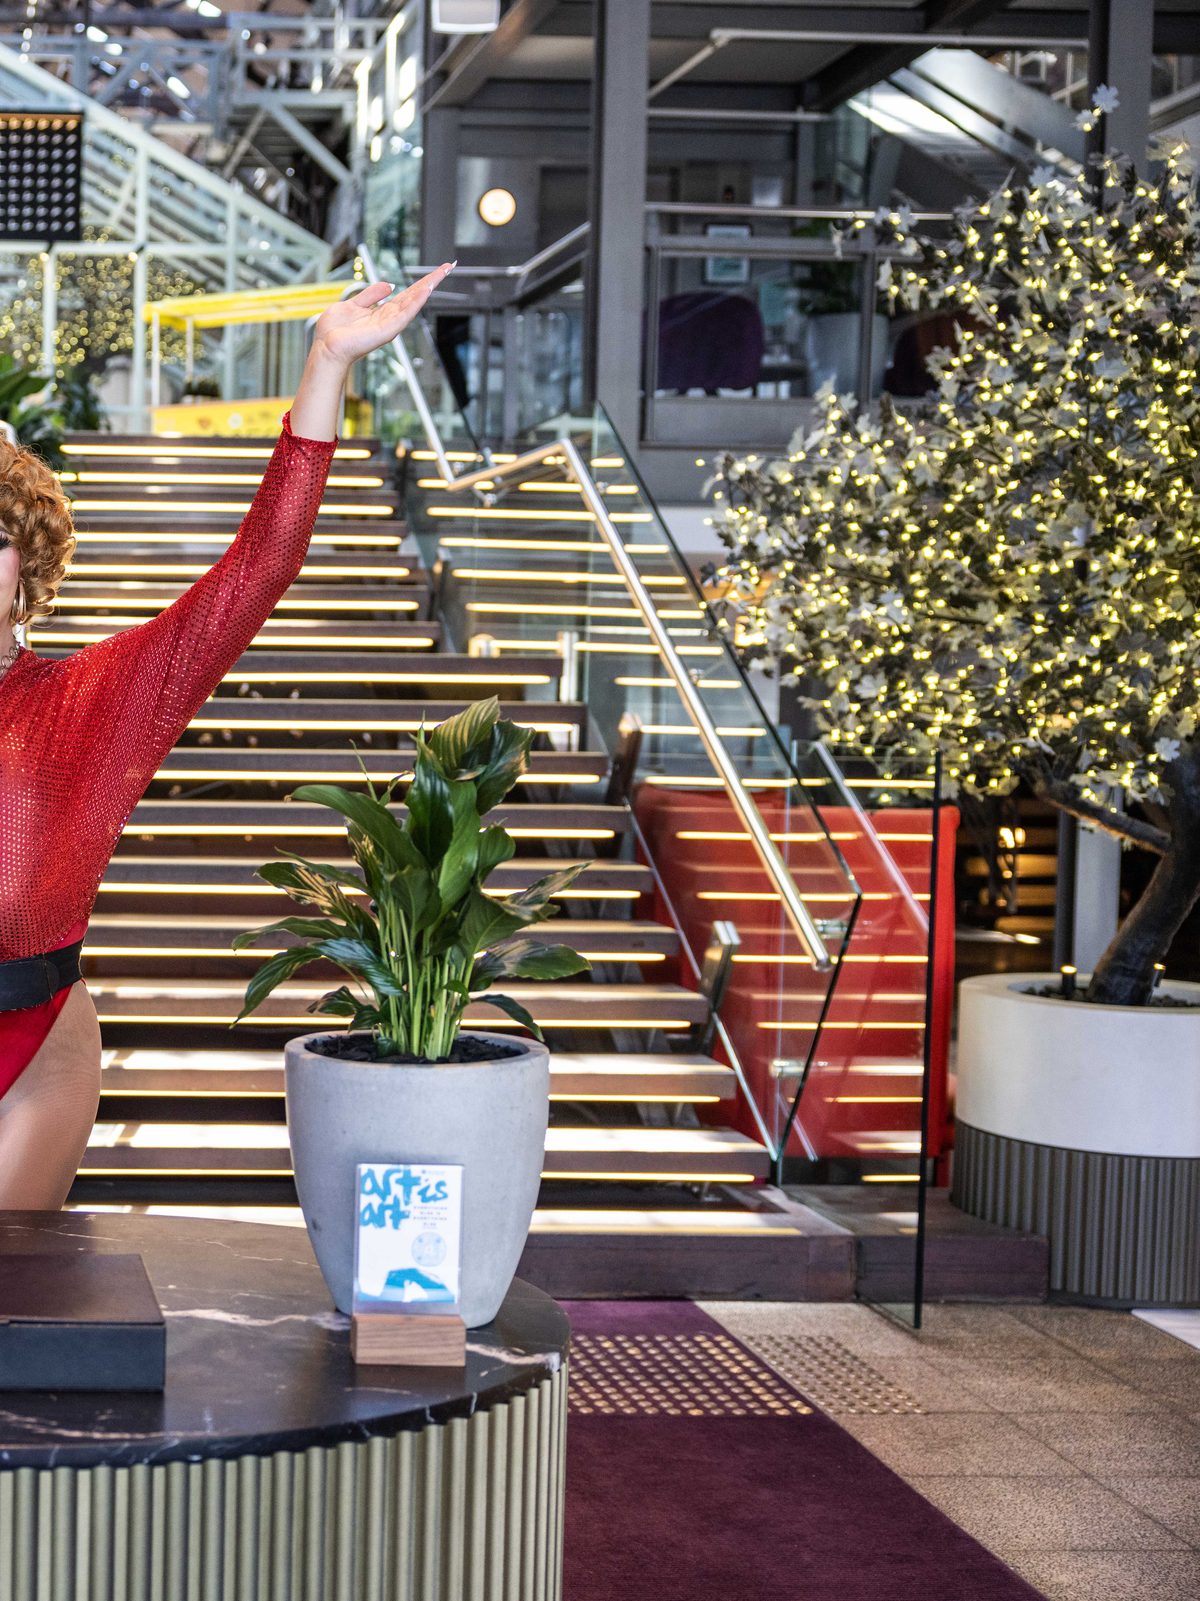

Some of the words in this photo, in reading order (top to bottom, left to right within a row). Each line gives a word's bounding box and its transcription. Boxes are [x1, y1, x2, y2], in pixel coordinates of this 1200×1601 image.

[360, 1167, 421, 1206] art
[418, 1178, 448, 1203] is
[360, 1194, 410, 1230] art
